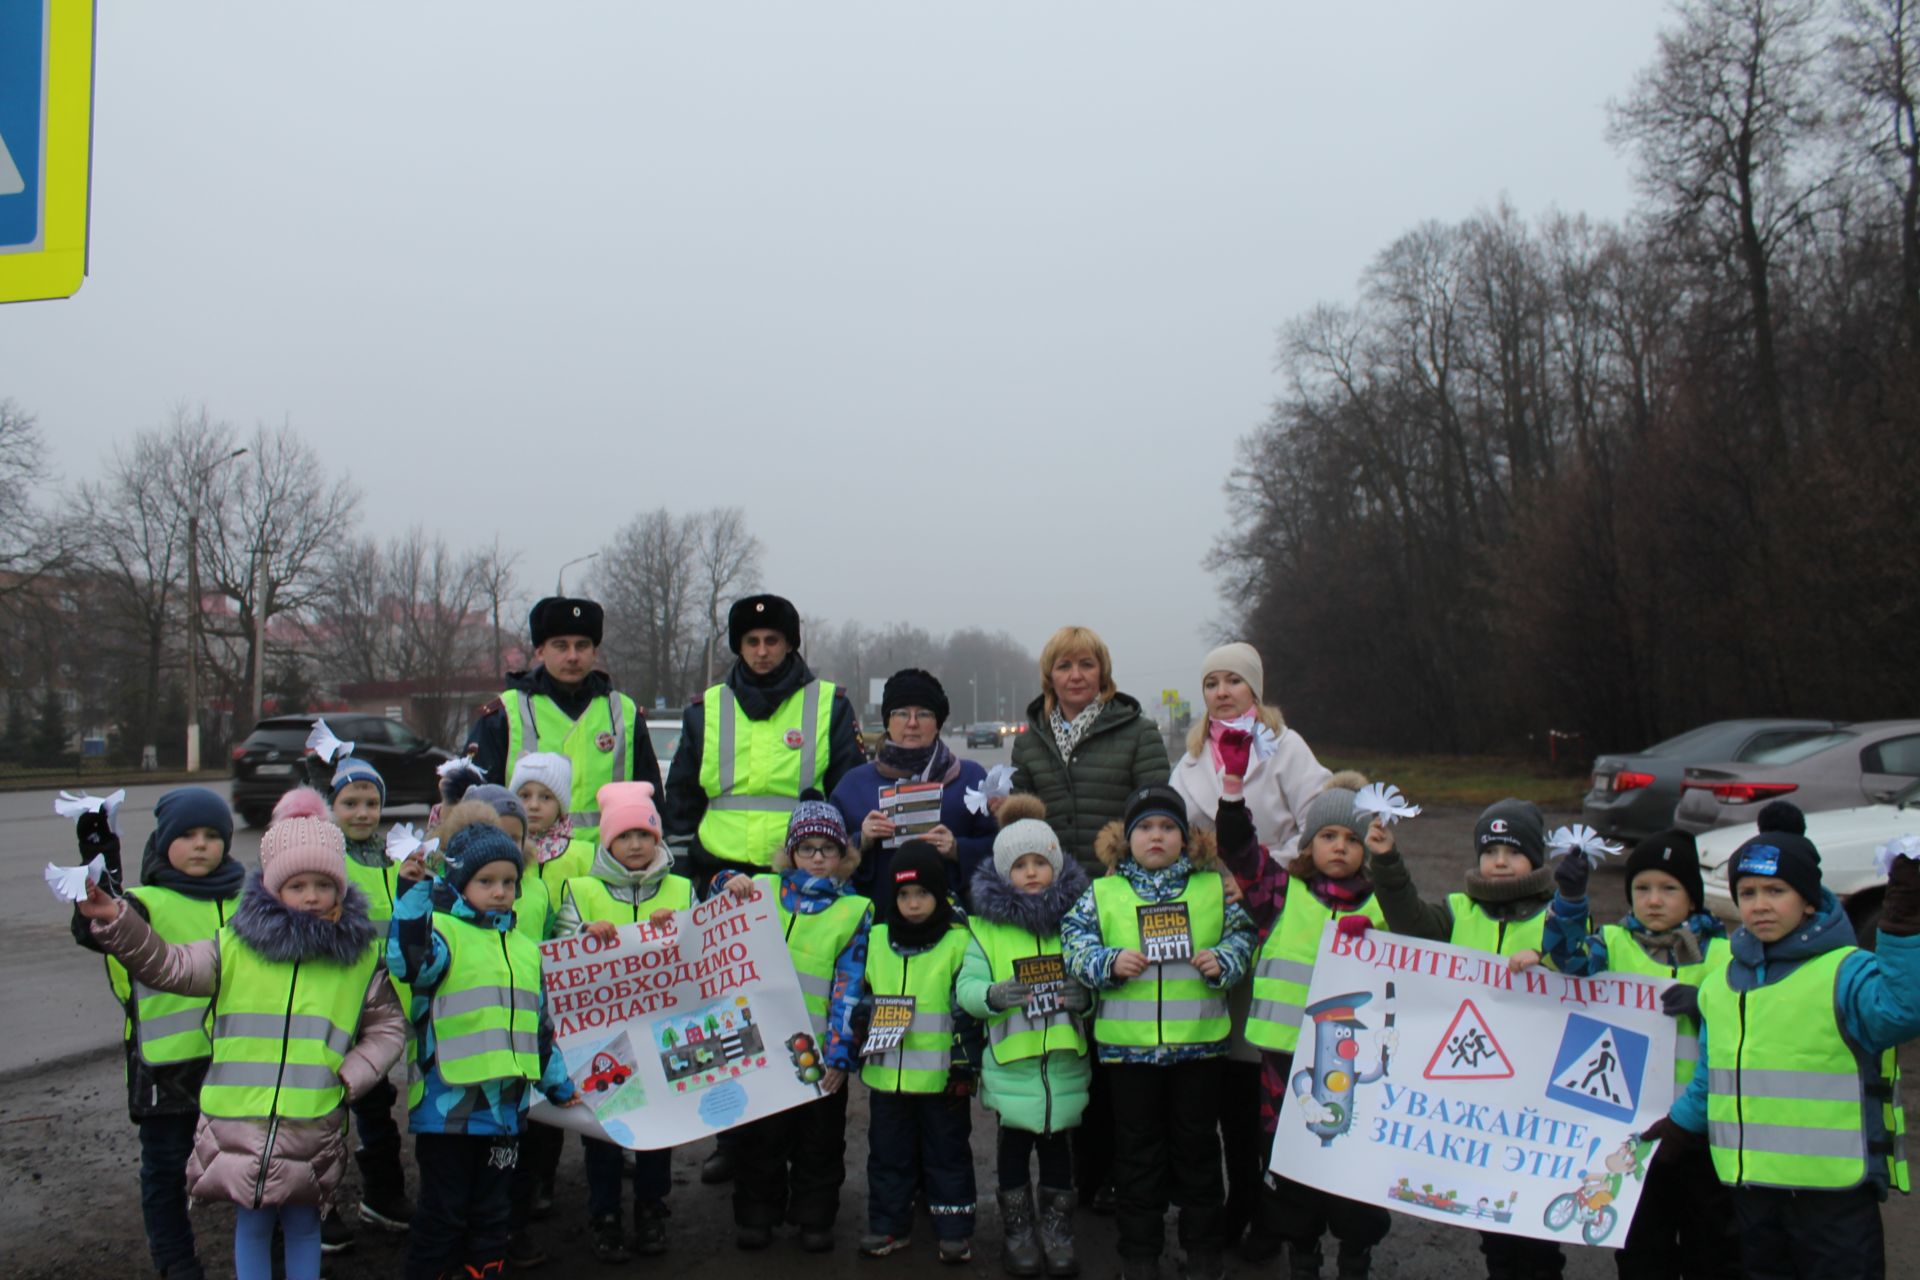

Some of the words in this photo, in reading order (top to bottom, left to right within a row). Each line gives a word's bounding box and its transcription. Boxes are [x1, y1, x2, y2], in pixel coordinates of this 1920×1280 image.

[637, 914, 678, 943] НЕ
[1143, 912, 1187, 930] ДЕНЬ
[701, 913, 751, 954] ДТП
[1143, 926, 1188, 939] ПАМЯТИ
[1145, 934, 1188, 945] ЖЕРТВ
[1147, 940, 1191, 963] ДТП
[1330, 928, 1513, 990] ВОДИТЕЛИ
[1525, 971, 1548, 995] И
[551, 942, 748, 1015] НЕОБХОДИМО
[1020, 960, 1062, 977] ДЕНЬ
[1020, 971, 1064, 985] ПАМЯТИ
[552, 990, 679, 1040] ЛЮДАТЬ
[698, 960, 761, 1000] ПДД
[872, 1018, 910, 1027] ПАМЯТИ
[873, 1005, 913, 1020] ДЕНЬ
[869, 1026, 905, 1035] ЖЕРТВ
[862, 1033, 901, 1054] ДТП
[1381, 1082, 1589, 1149] УВАЖАЙТЕ
[1368, 1116, 1493, 1168] ЗНАКИ
